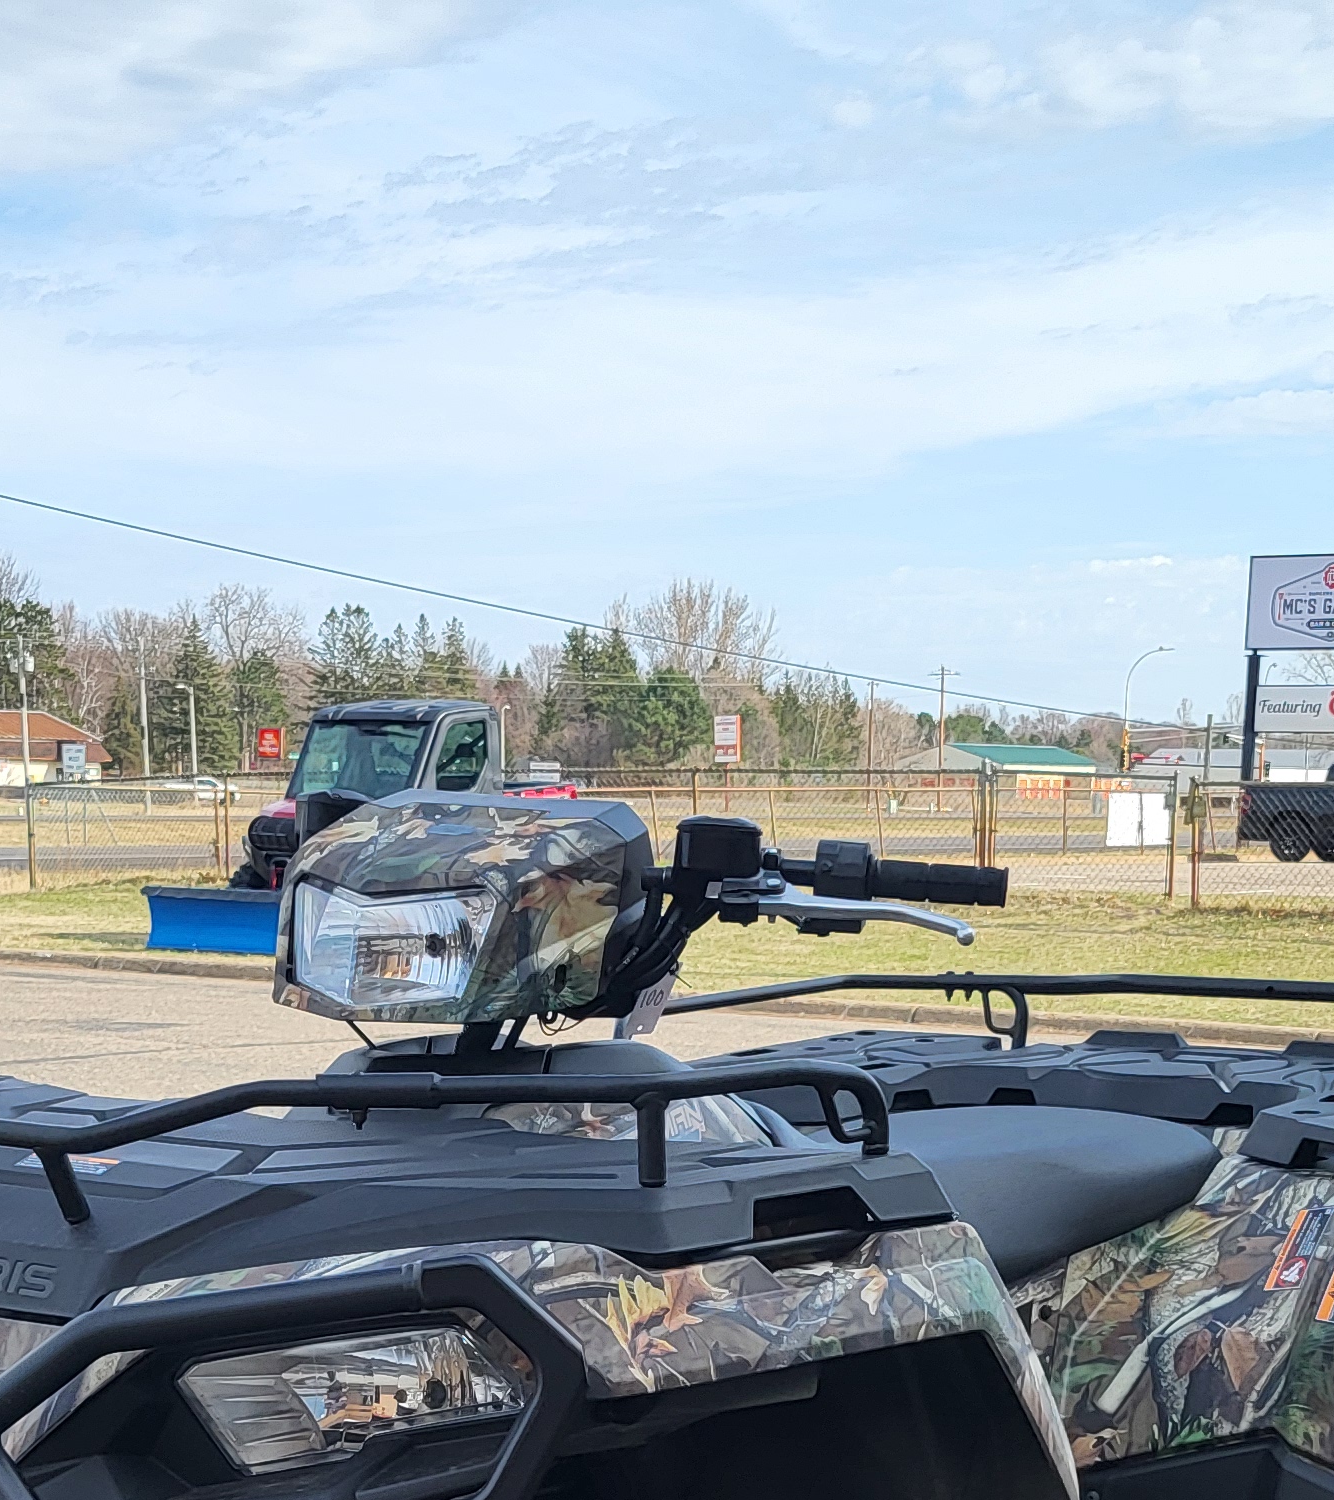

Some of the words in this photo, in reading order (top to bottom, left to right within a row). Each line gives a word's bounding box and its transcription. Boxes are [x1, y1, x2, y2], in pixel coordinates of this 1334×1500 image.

[1282, 597, 1316, 615] MC'S
[1259, 700, 1322, 717] Featuring
[640, 989, 664, 1008] 100
